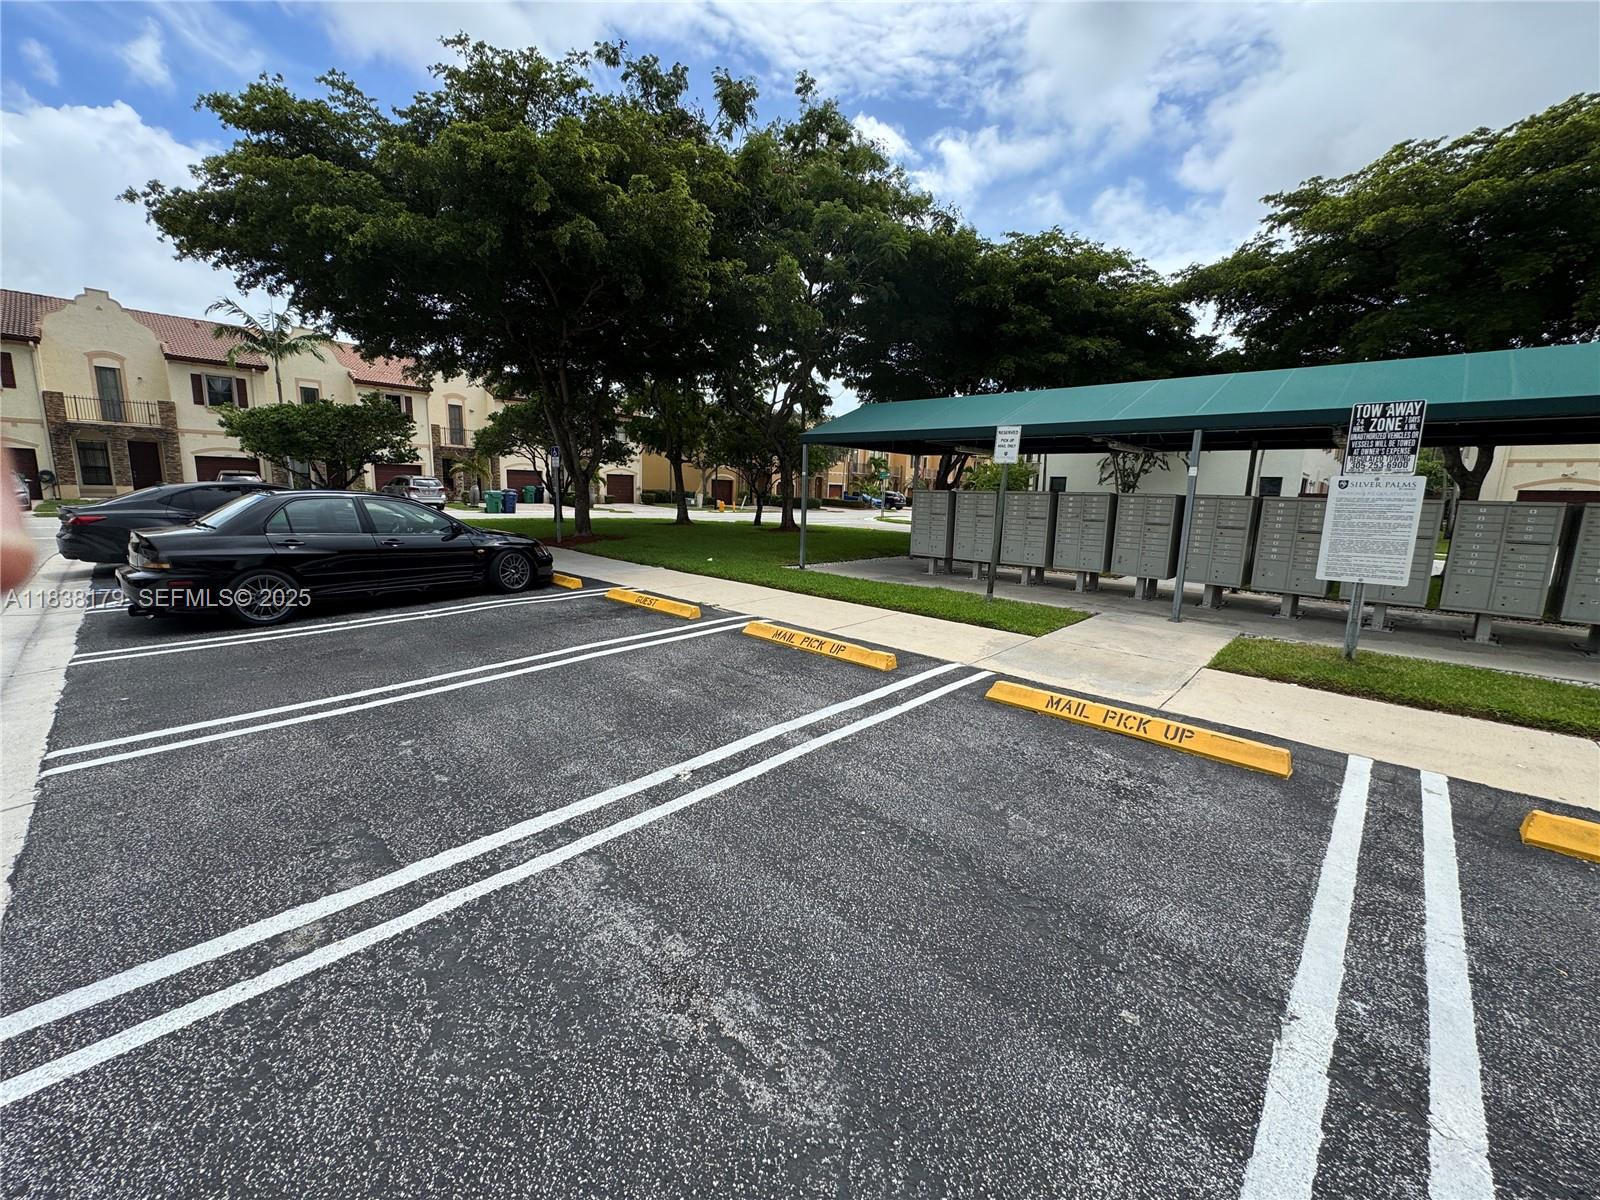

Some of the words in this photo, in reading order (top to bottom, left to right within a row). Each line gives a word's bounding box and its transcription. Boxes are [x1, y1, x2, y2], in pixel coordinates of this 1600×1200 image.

[1356, 404, 1383, 418] TOW
[1386, 401, 1422, 417] AWAY
[1356, 418, 1365, 426] 24
[1408, 415, 1421, 423] DAYS
[1369, 417, 1403, 432] ZONE
[1387, 431, 1411, 439] VEHICLES
[1411, 431, 1419, 439] OR
[1351, 440, 1374, 448] VESSELS
[1397, 439, 1416, 447] TOWED
[1361, 447, 1385, 455] OWNER'S
[1386, 447, 1411, 455] EXPENSE
[635, 595, 658, 607] GUEST
[772, 629, 796, 644] MAIL
[800, 636, 825, 651] PICK
[829, 644, 847, 656] UP
[1045, 695, 1090, 719] MAIL
[1102, 709, 1152, 735] PICK
[1163, 724, 1196, 744] UP
